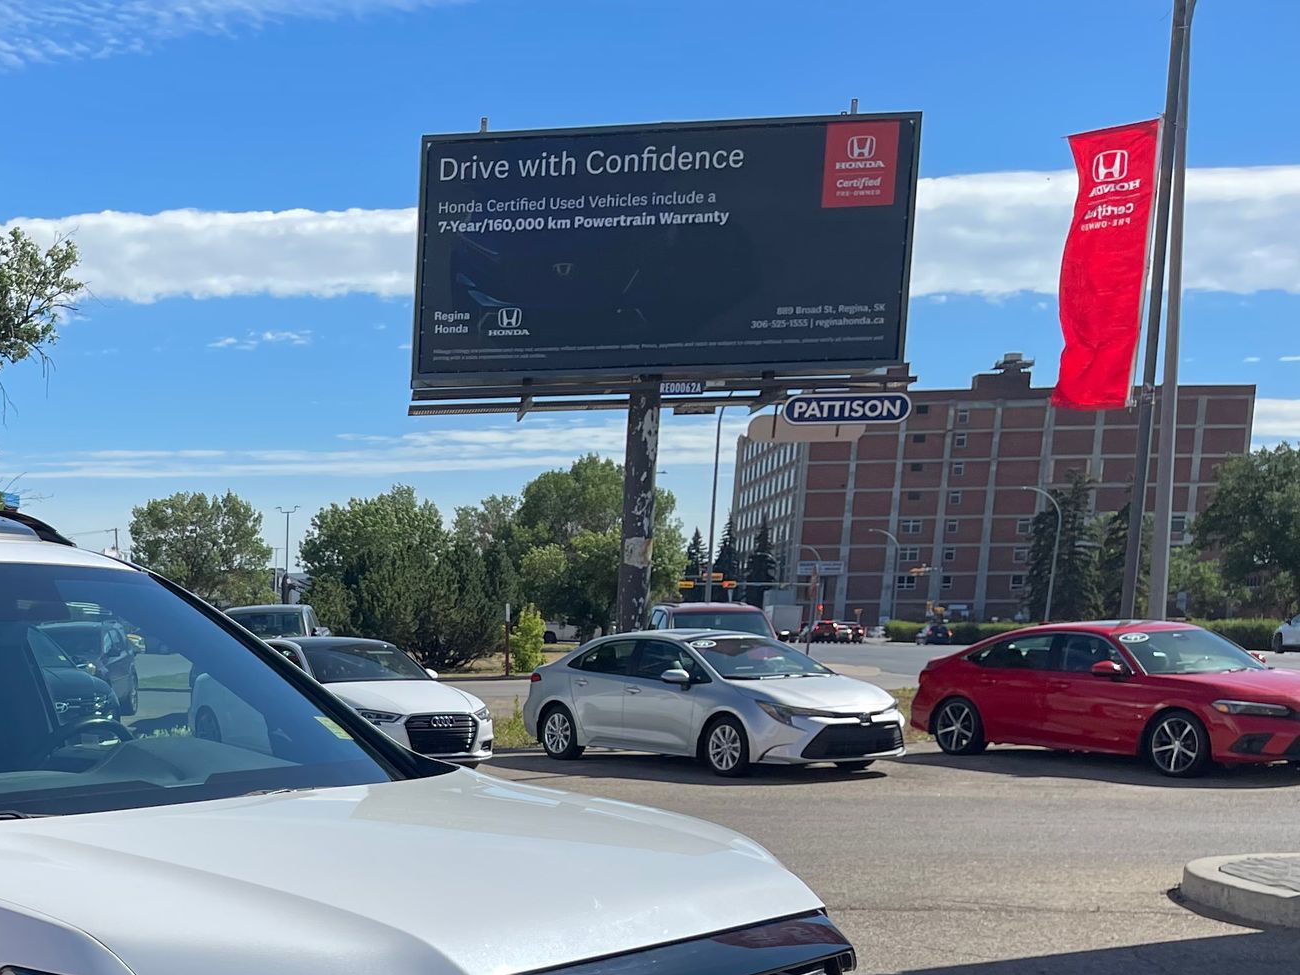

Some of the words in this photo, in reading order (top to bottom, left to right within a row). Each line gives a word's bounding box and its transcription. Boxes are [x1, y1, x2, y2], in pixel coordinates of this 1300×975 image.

[439, 155, 510, 181] Drive
[518, 150, 576, 178] with
[586, 145, 745, 175] Confidence
[835, 160, 886, 169] HONDA
[836, 177, 882, 189] Certified
[438, 200, 483, 214] Honda
[486, 197, 546, 212] Certified
[550, 195, 585, 210] Used
[589, 193, 648, 208] Vehicles
[651, 190, 704, 205] include
[707, 193, 716, 203] a
[438, 216, 545, 234] 7-Year/160,000
[548, 216, 571, 230] km
[574, 213, 656, 229] Powertrain
[659, 210, 730, 226] Warranty
[795, 304, 822, 315] Broad
[838, 304, 872, 315] Regina,
[873, 303, 886, 312] SK
[434, 310, 470, 323] Regina
[815, 316, 885, 329] reginahonda.ca
[434, 324, 469, 334] Honda
[659, 382, 701, 393] RE00062A
[793, 399, 901, 418] PATTISON
